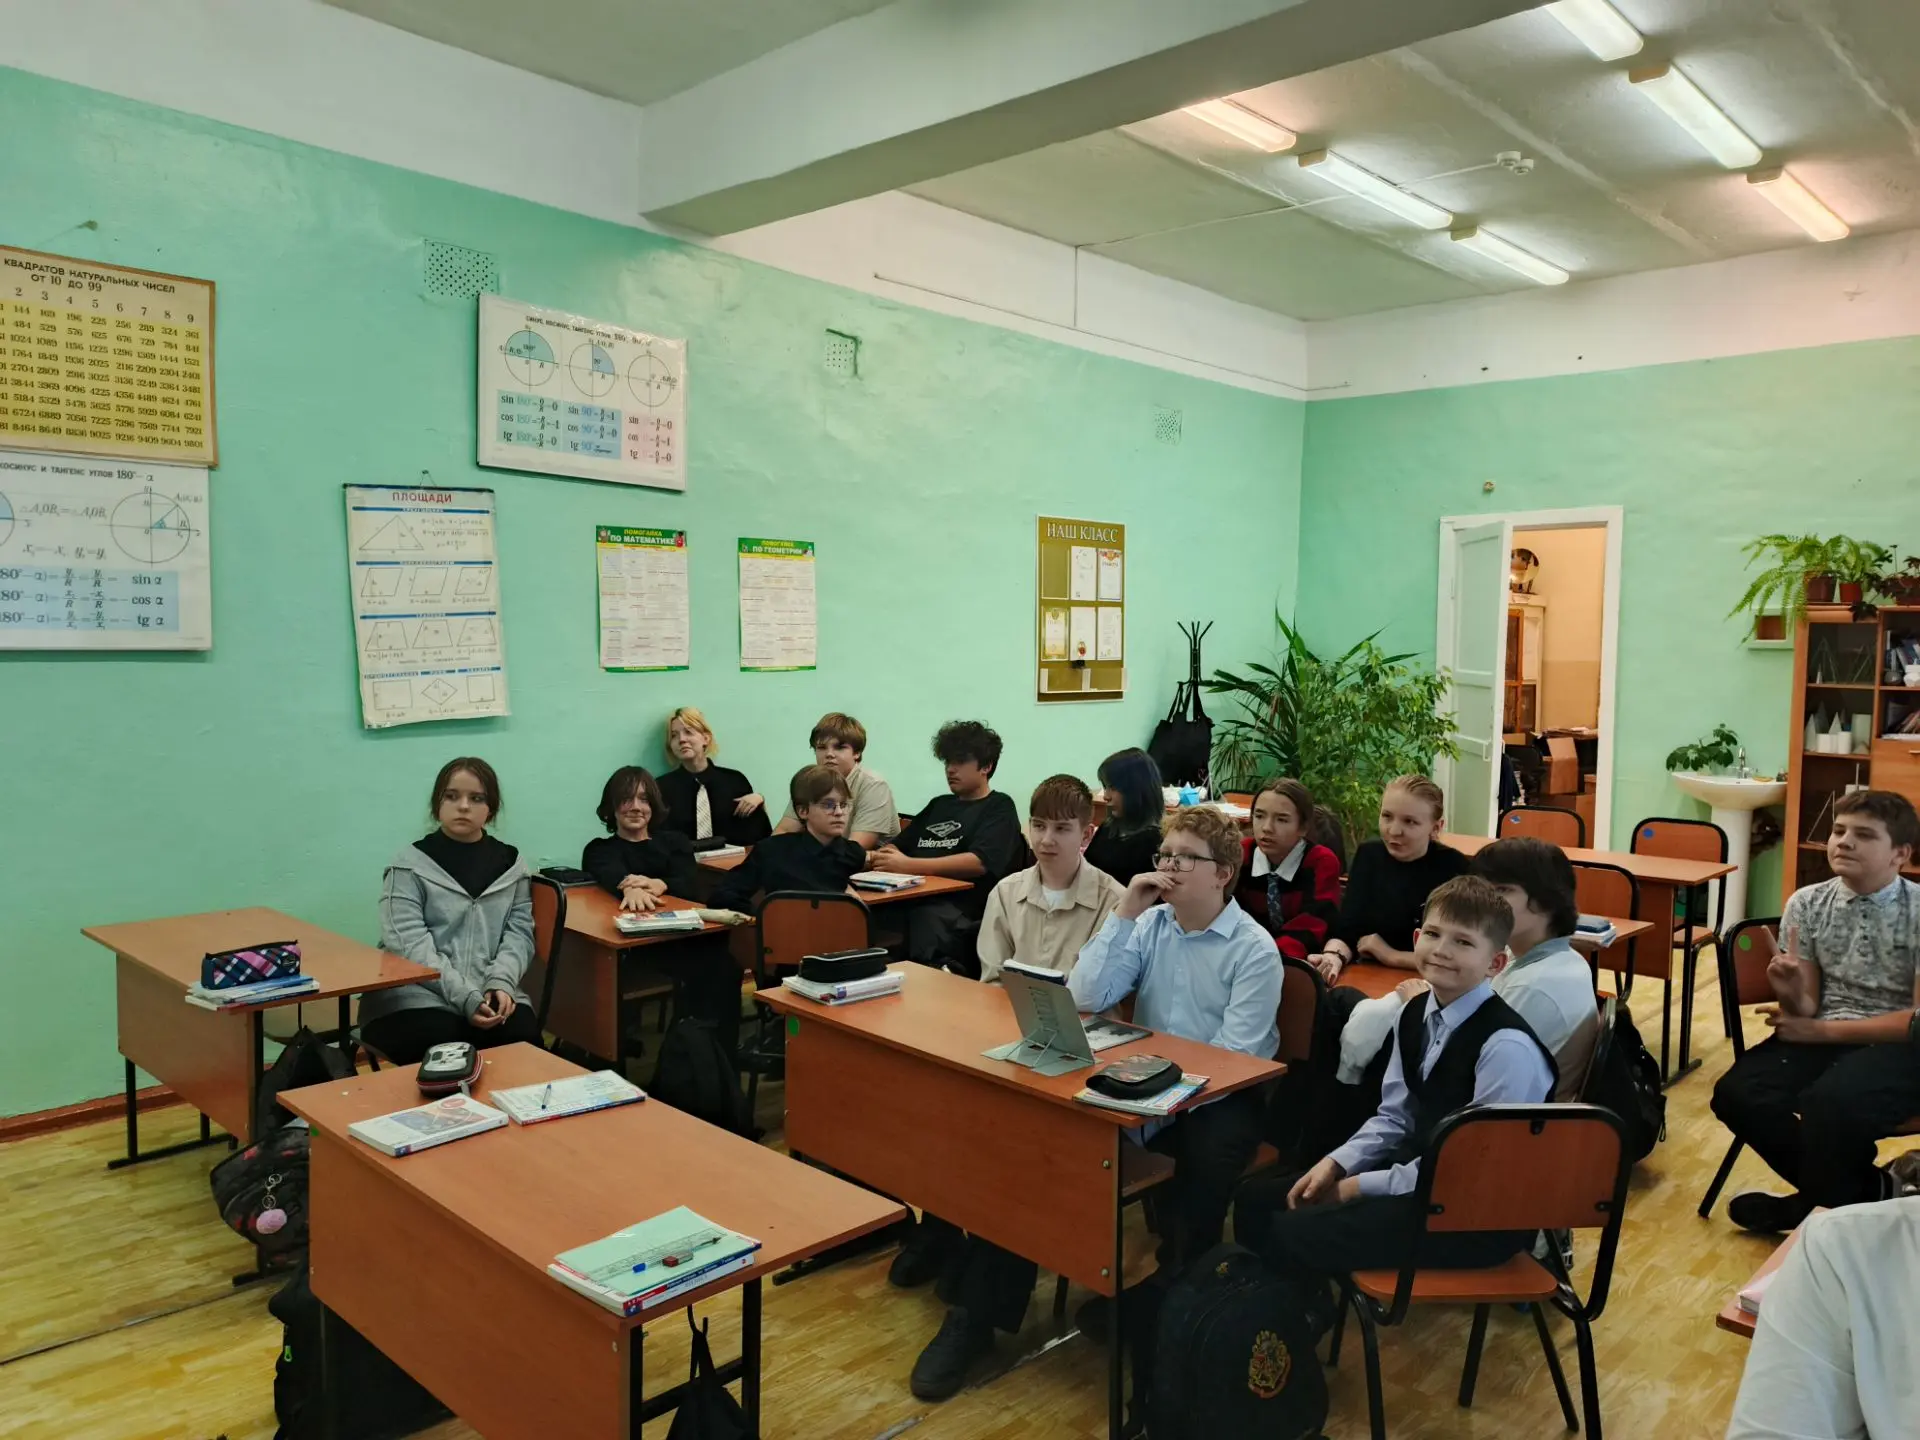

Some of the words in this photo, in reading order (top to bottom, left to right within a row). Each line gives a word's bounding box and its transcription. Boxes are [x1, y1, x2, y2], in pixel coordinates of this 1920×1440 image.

[4, 258, 65, 276] КВАДРАТОВ
[69, 270, 140, 288] НАТУРАЛЬНЫХ
[142, 281, 175, 293] ЧИСЕЛ
[31, 274, 46, 282] ОТ
[51, 275, 62, 285] 10
[68, 280, 83, 289] ДО
[88, 281, 102, 292] 99
[16, 287, 22, 296] 2
[42, 291, 48, 300] 3
[92, 299, 99, 308] 5
[116, 303, 123, 312] 6
[141, 306, 147, 316] 7
[164, 310, 171, 319] 8
[187, 314, 194, 323] 9
[501, 395, 514, 404] sin
[568, 406, 579, 415] sin
[501, 413, 514, 422] cos
[629, 416, 639, 424] sin
[568, 424, 579, 432] cos
[392, 492, 452, 503] ПЛОЩАДИ
[1048, 523, 1076, 538] НАШ
[1080, 526, 1118, 542] КЛАСС
[624, 536, 675, 544] МАТЕМАТИКЕ
[917, 837, 960, 849] balenciaga
